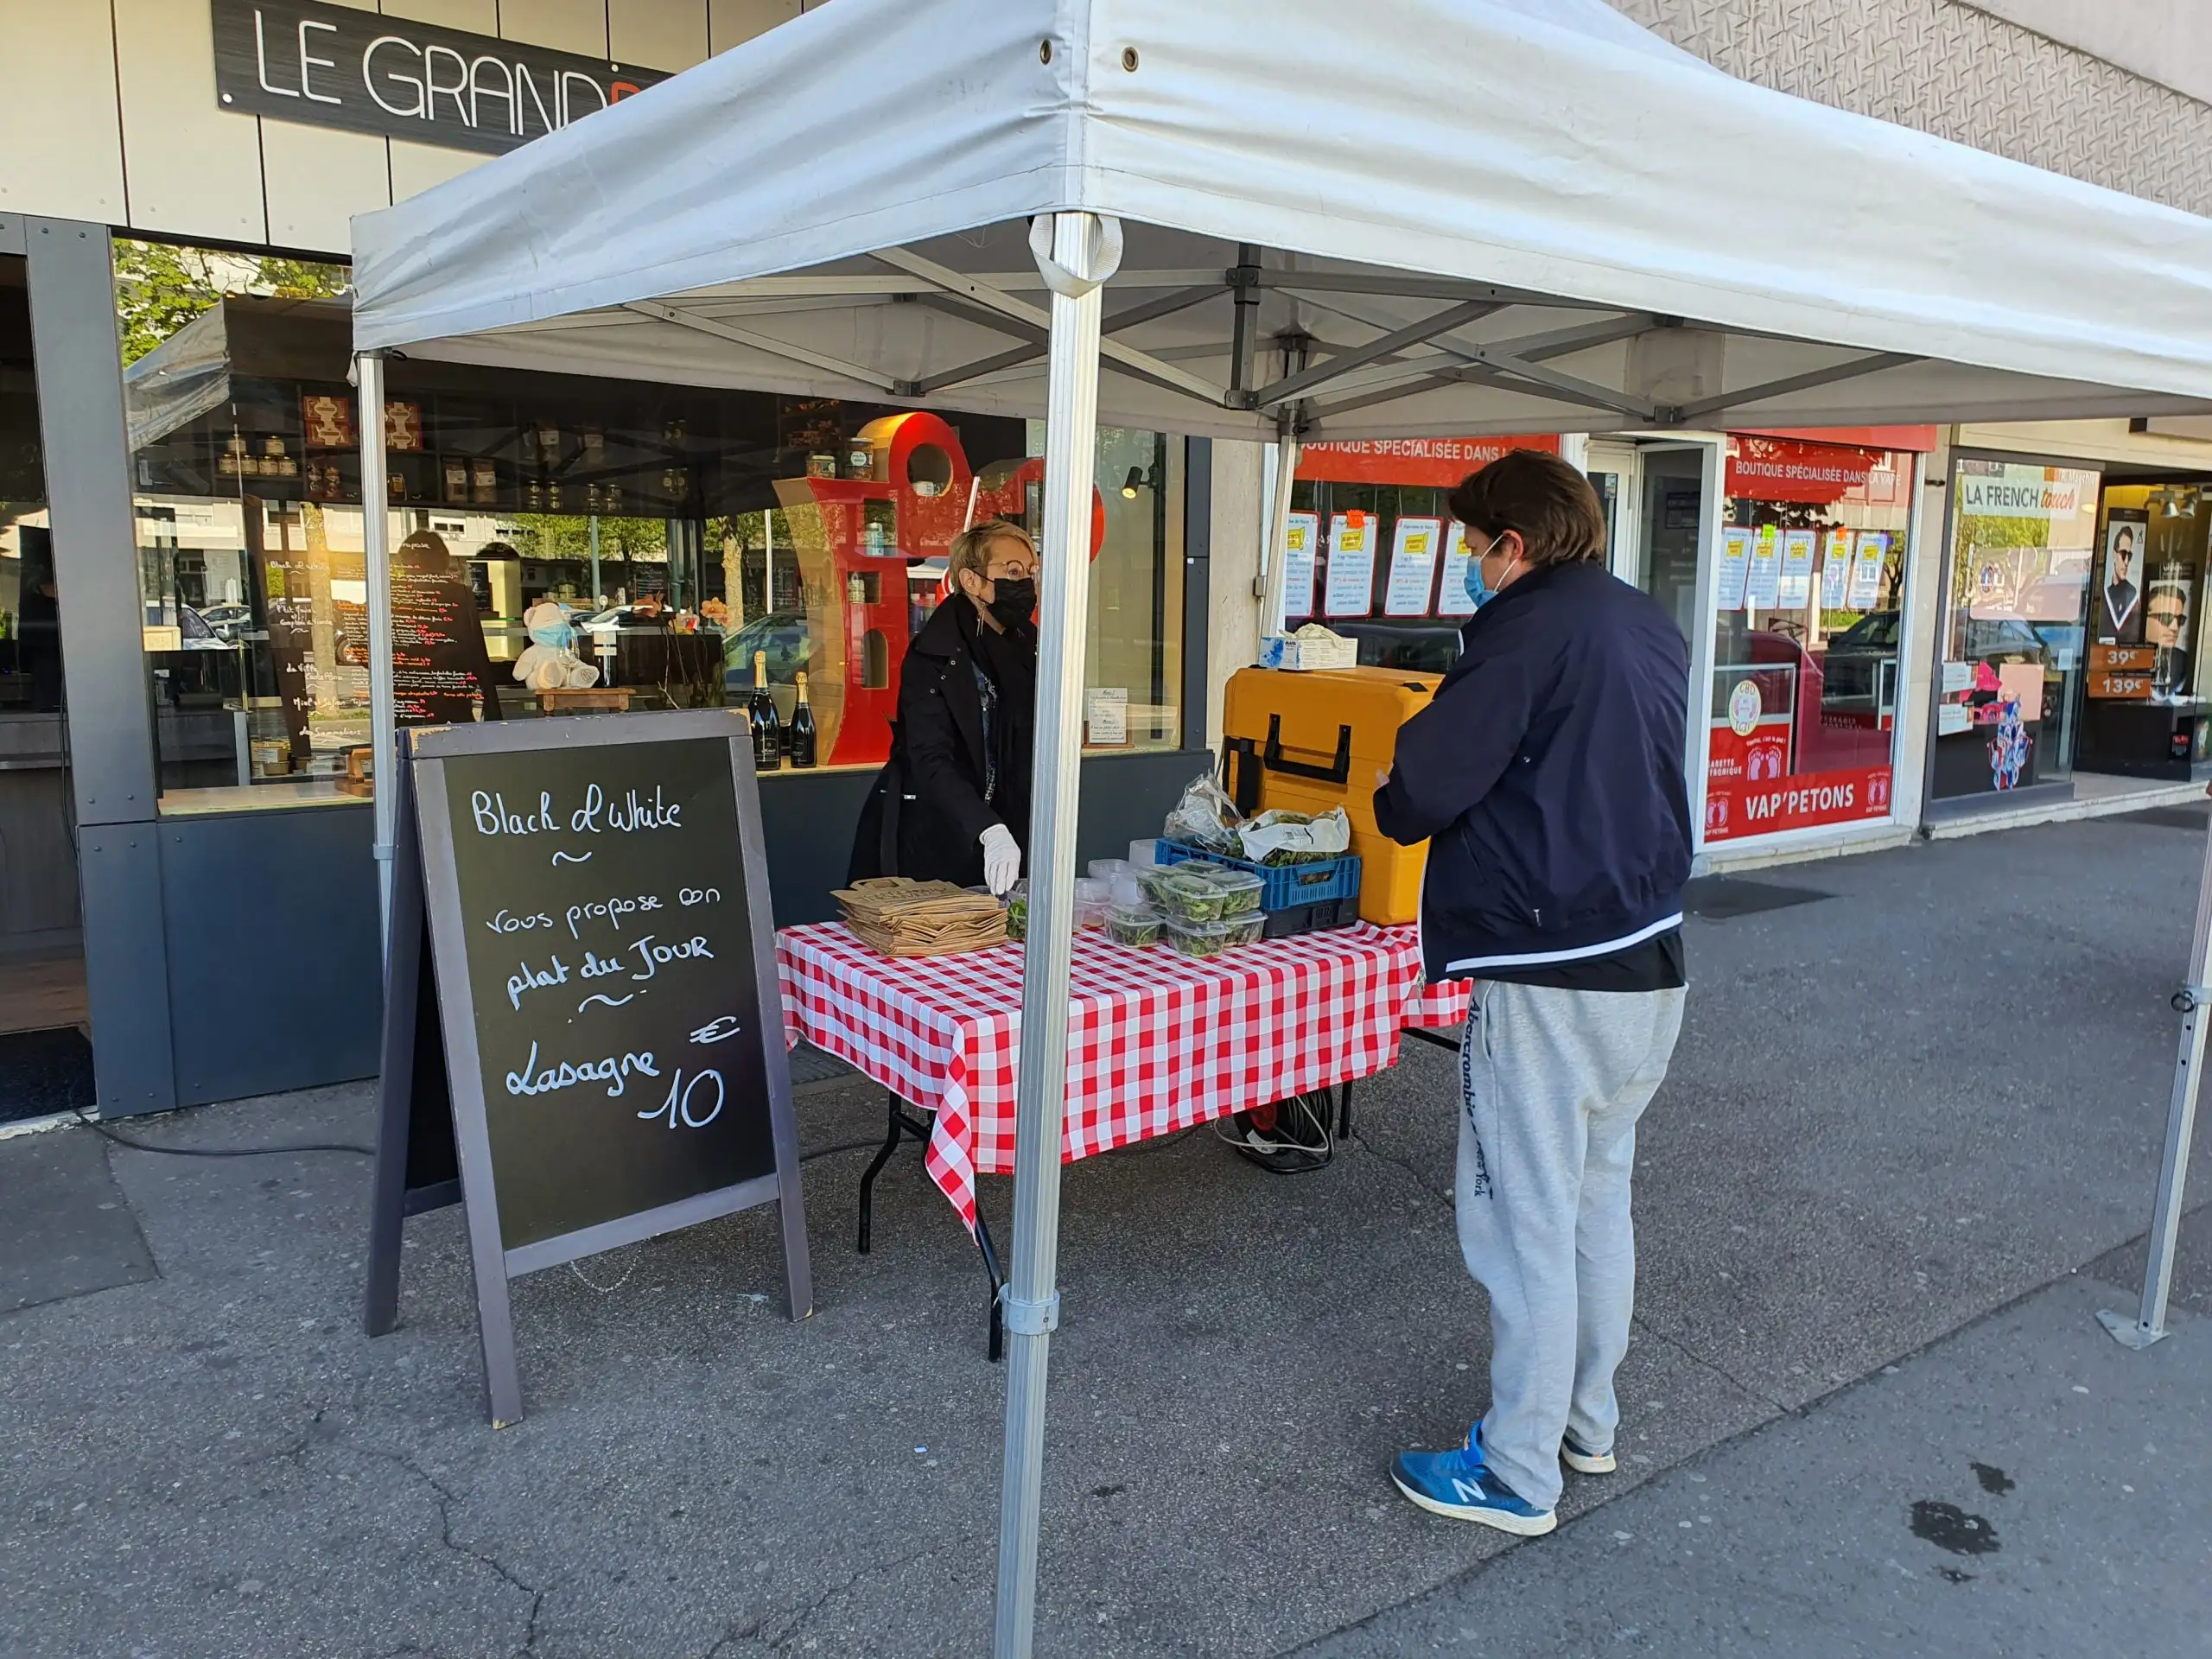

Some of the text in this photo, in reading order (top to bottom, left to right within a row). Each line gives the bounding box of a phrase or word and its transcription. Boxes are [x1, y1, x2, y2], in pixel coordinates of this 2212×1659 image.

[255, 10, 342, 105] LE
[1301, 442, 1370, 454] OUTIQUE
[1464, 445, 1498, 461] DANS
[1736, 460, 1783, 478] BOUTIQUE
[1786, 462, 1841, 483] SPÉCIALISÉE
[1844, 469, 1866, 484] DANS
[1966, 484, 2075, 510] LA FRENCH touch
[471, 790, 561, 836] Black
[608, 785, 682, 832] White
[1745, 783, 1853, 821] VAP'PETONS
[566, 895, 664, 940] propose
[506, 954, 570, 1012] plat
[580, 951, 626, 979] du
[1462, 995, 1481, 1118] Abercrombie
[505, 1039, 724, 1129] Lasagne 10
